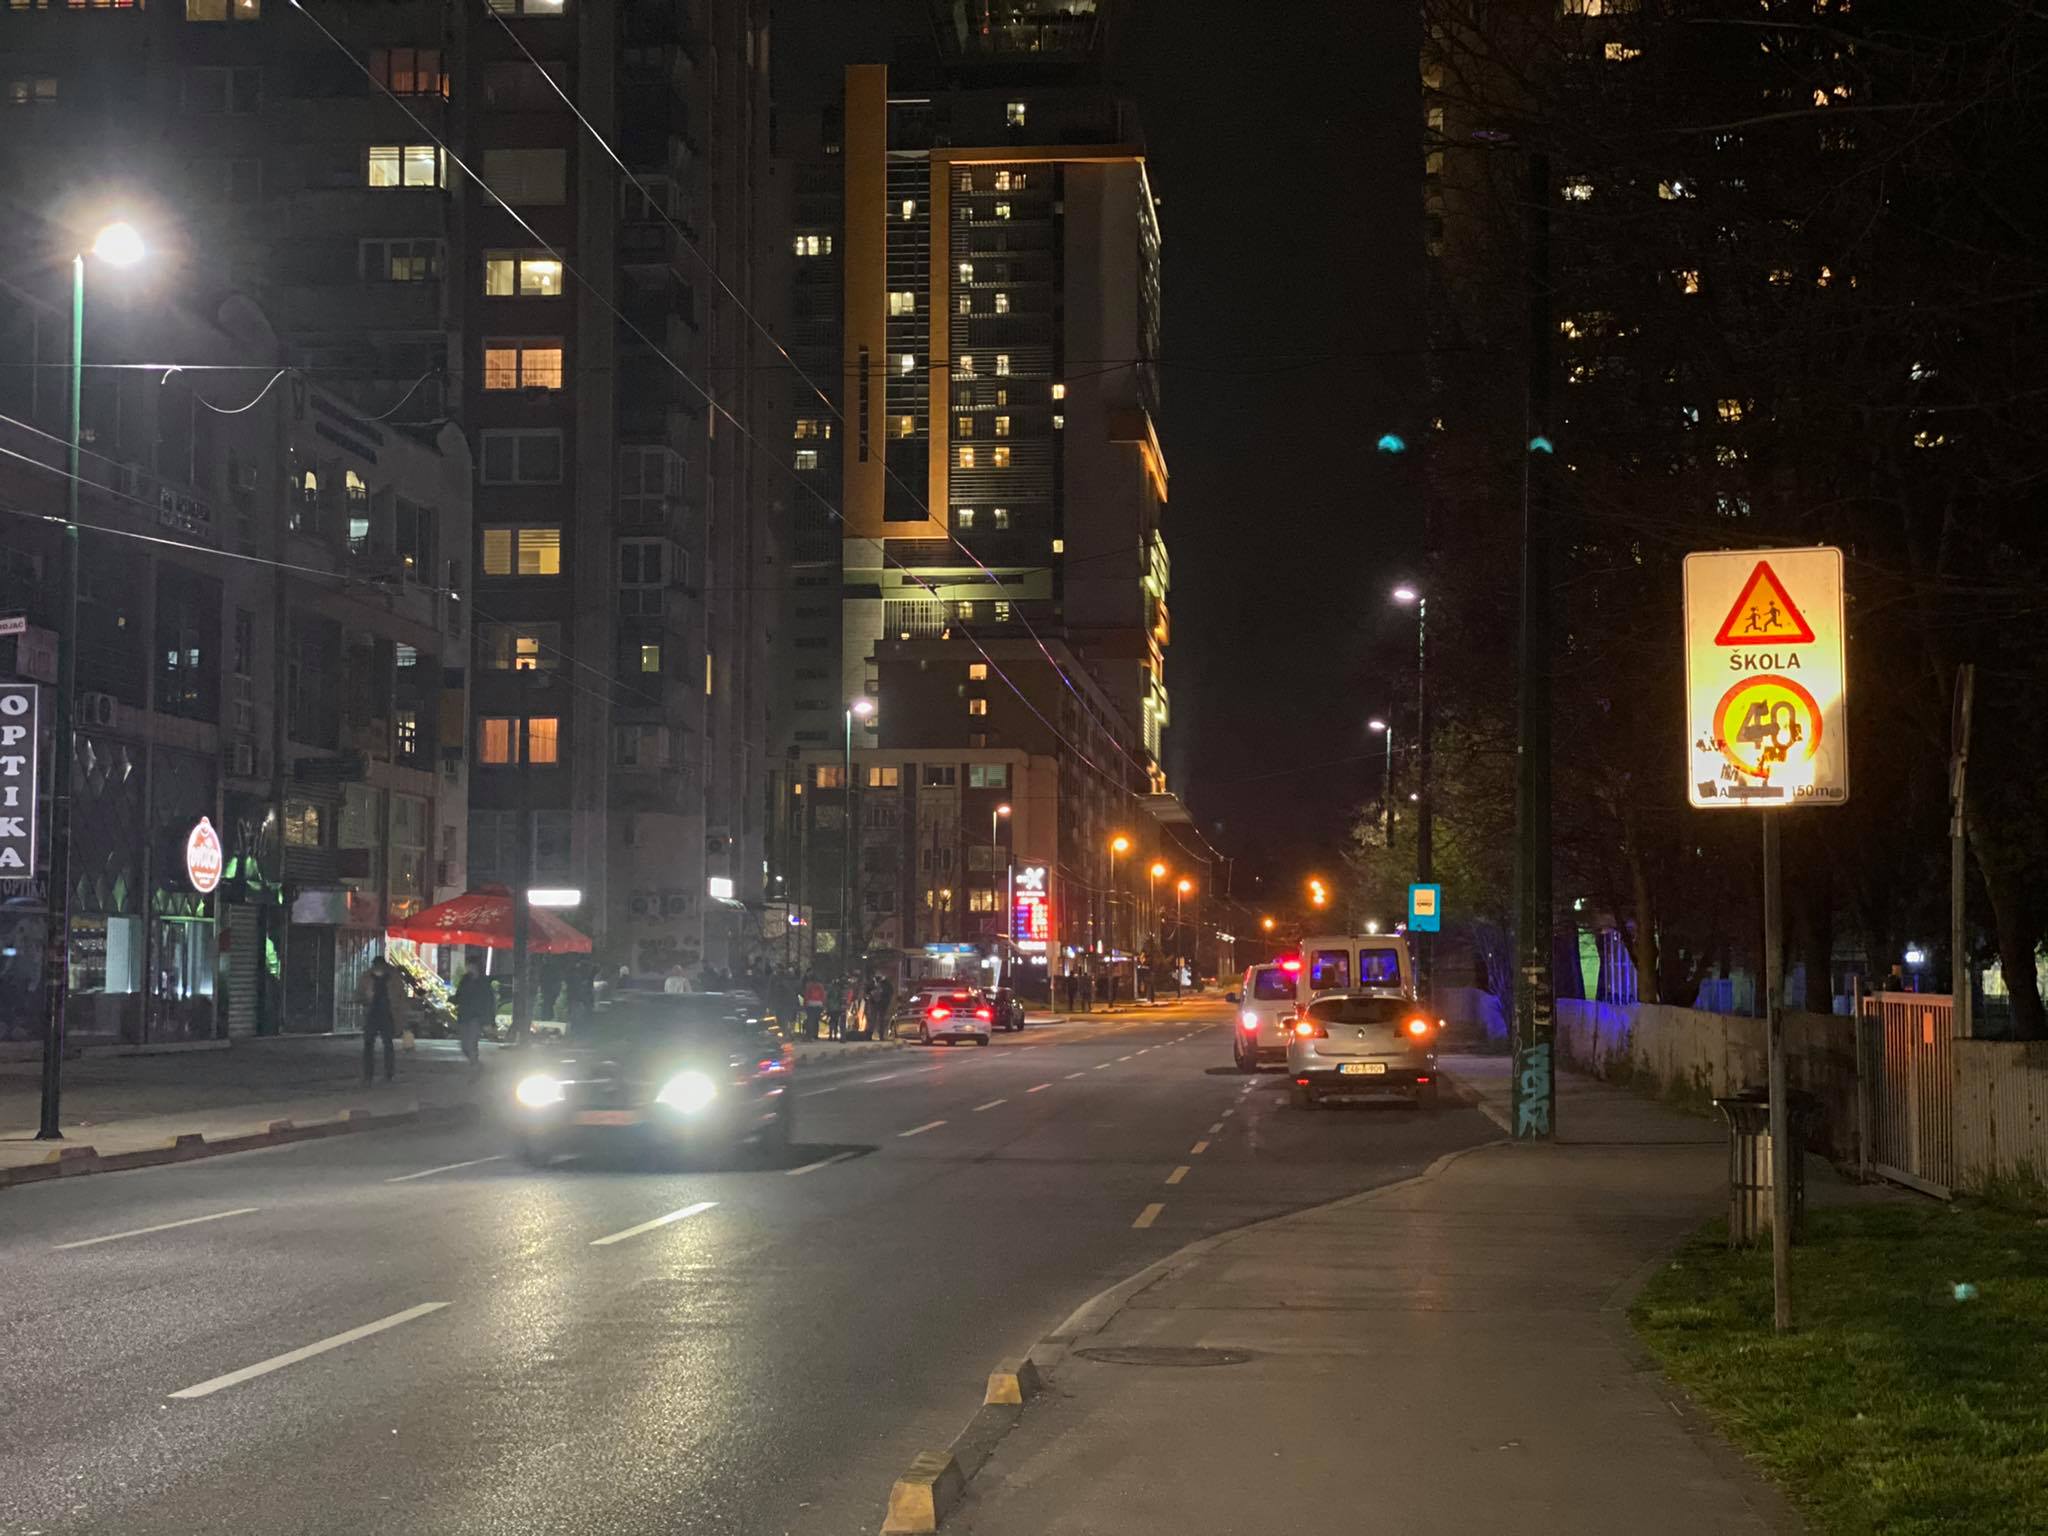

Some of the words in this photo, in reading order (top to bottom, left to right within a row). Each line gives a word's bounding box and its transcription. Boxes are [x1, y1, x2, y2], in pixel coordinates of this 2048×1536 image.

[1730, 649, 1801, 671] ŠKOLA
[0, 695, 29, 868] OPTIKA
[3, 879, 47, 898] OPTIKA
